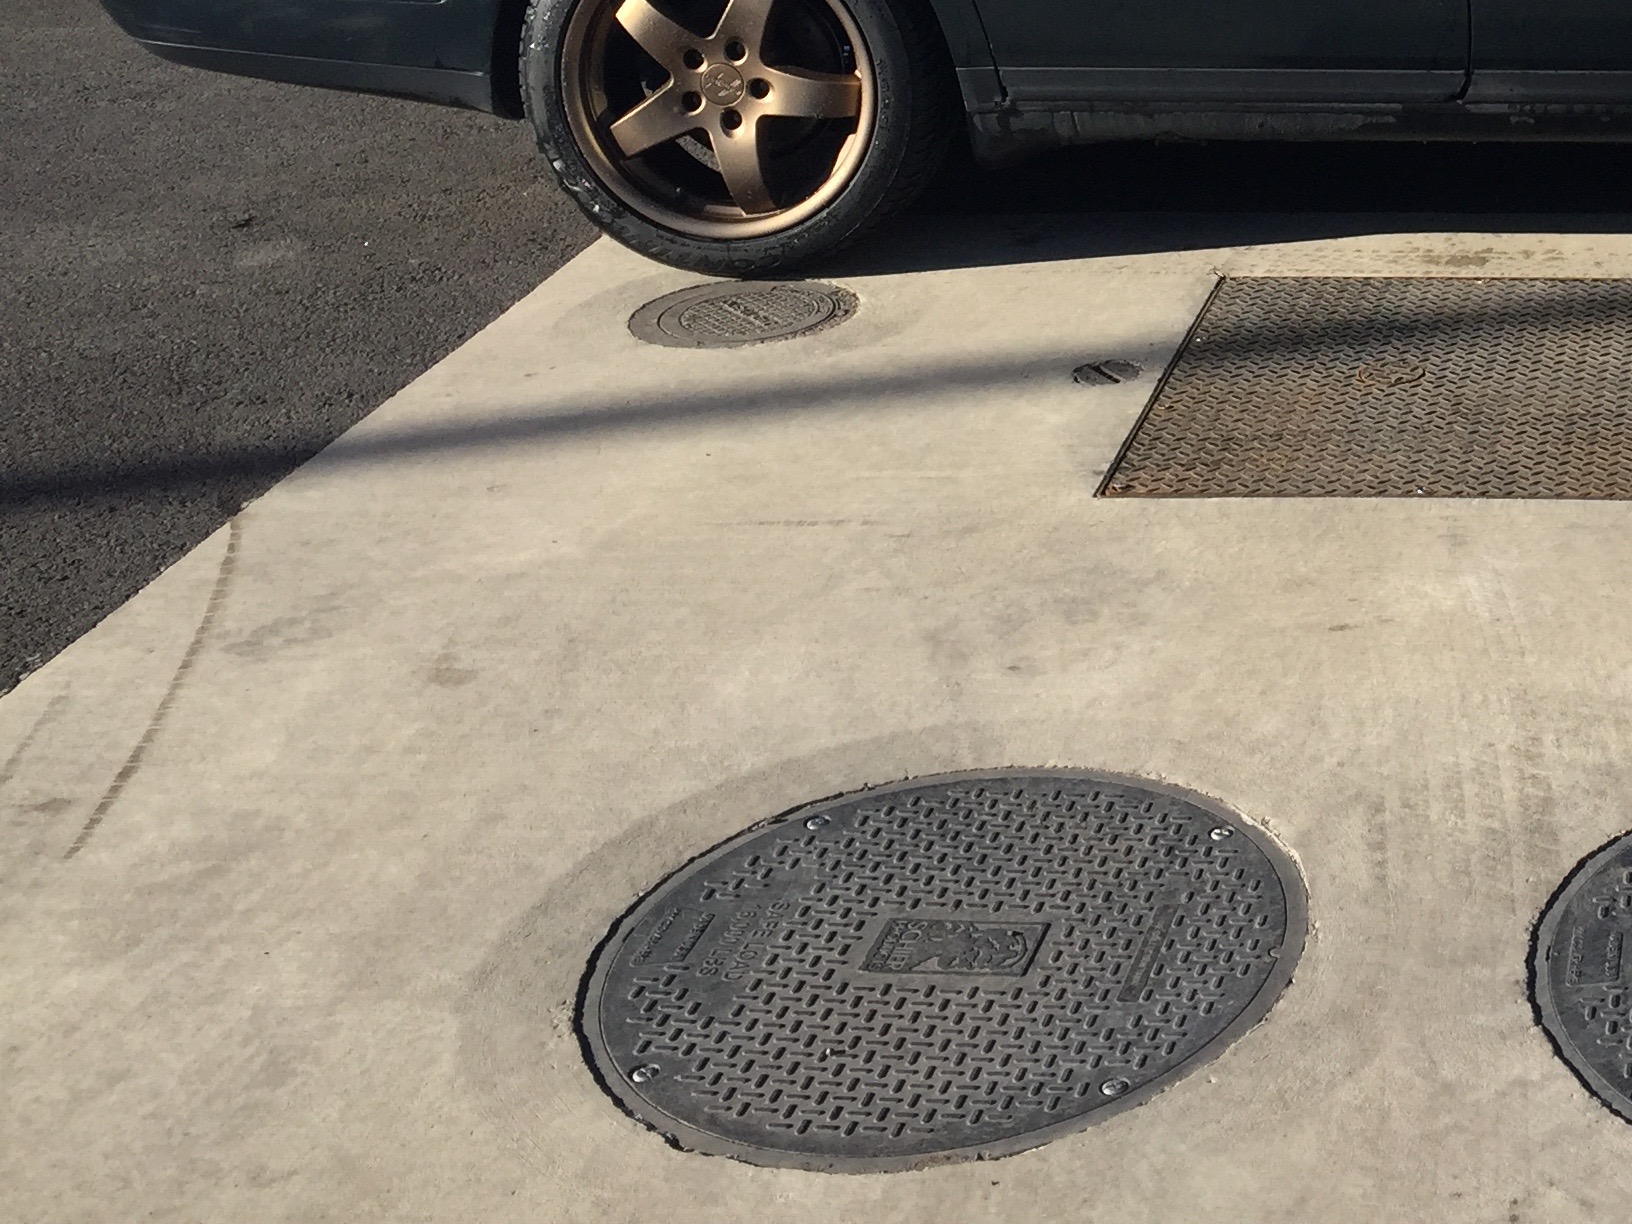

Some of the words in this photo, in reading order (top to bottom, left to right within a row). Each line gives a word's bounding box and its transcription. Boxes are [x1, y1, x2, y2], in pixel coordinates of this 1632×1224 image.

[718, 903, 763, 945] 6,000
[750, 898, 792, 939] SAFE
[696, 948, 733, 977] LBS
[721, 941, 765, 982] LOAD
[886, 921, 928, 971] SCHIER
